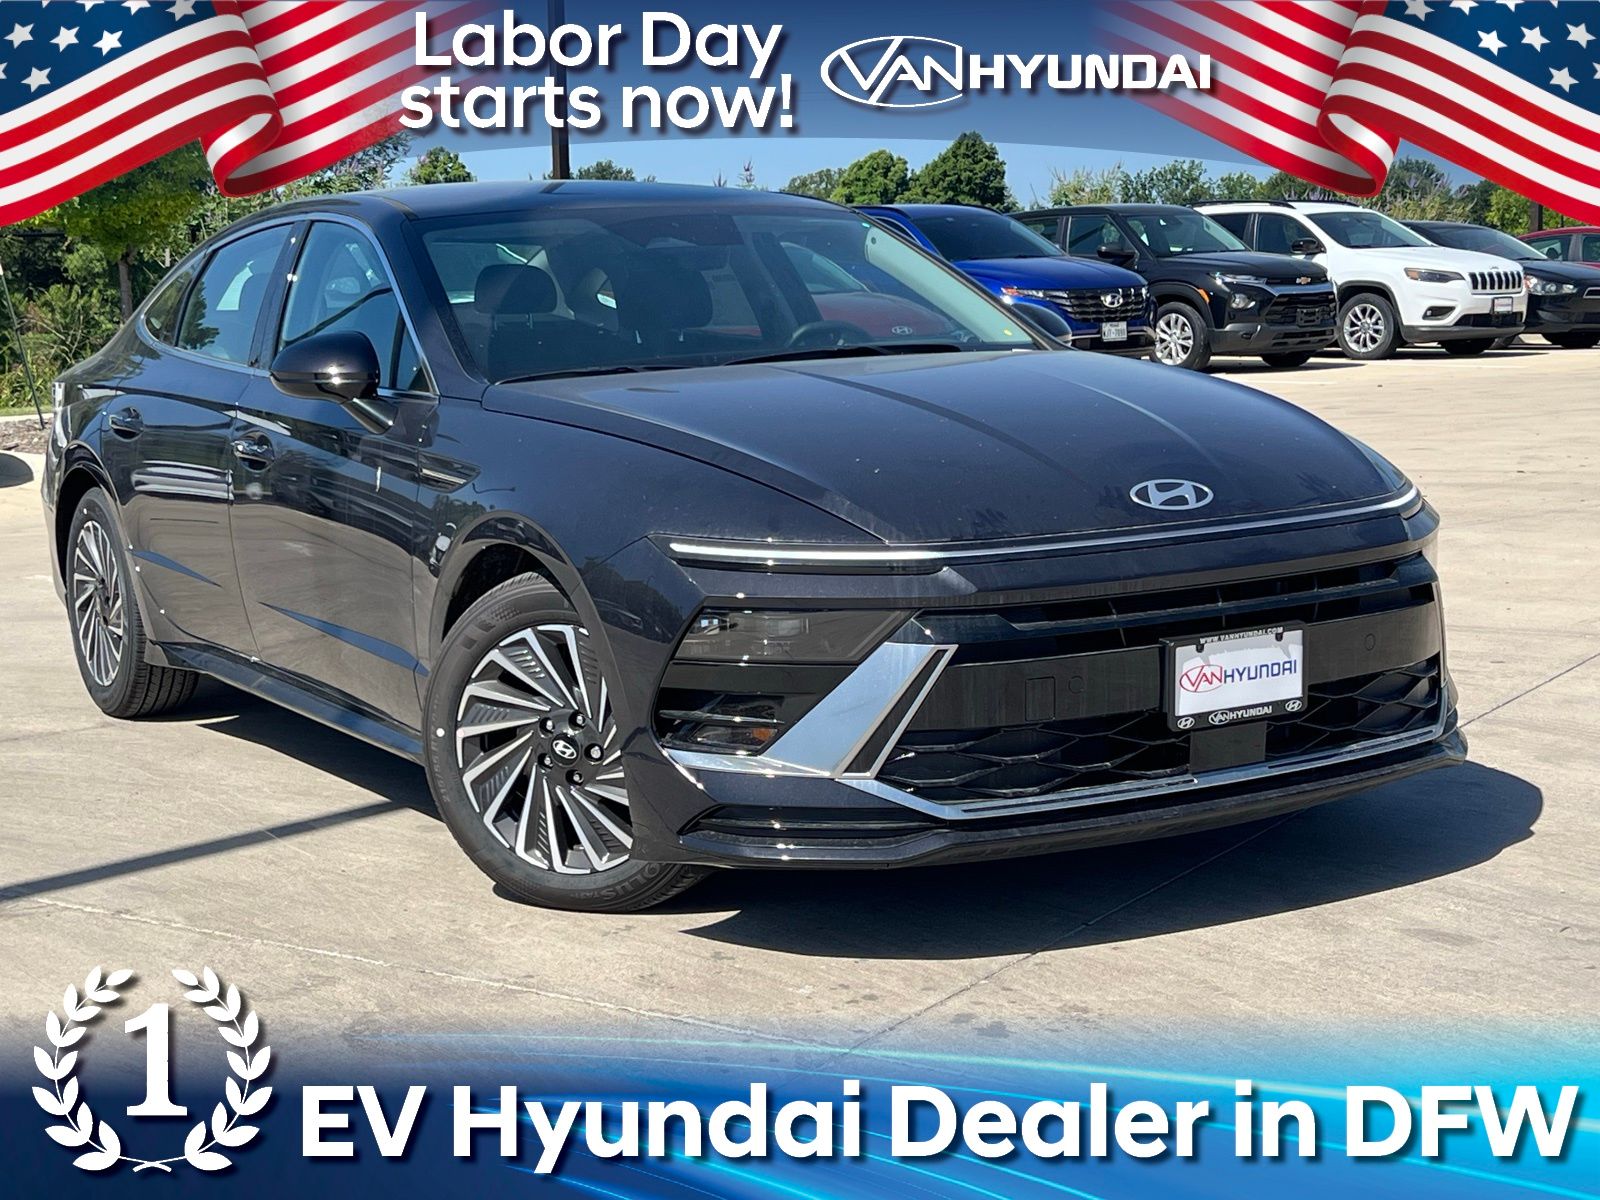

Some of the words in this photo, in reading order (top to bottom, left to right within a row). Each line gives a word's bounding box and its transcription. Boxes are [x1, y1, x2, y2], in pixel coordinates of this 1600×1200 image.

[1184, 666, 1223, 692] VAN
[1224, 659, 1297, 684] HYUNDAI
[1211, 711, 1230, 724] VAN
[1229, 705, 1272, 720] HYUNDAI
